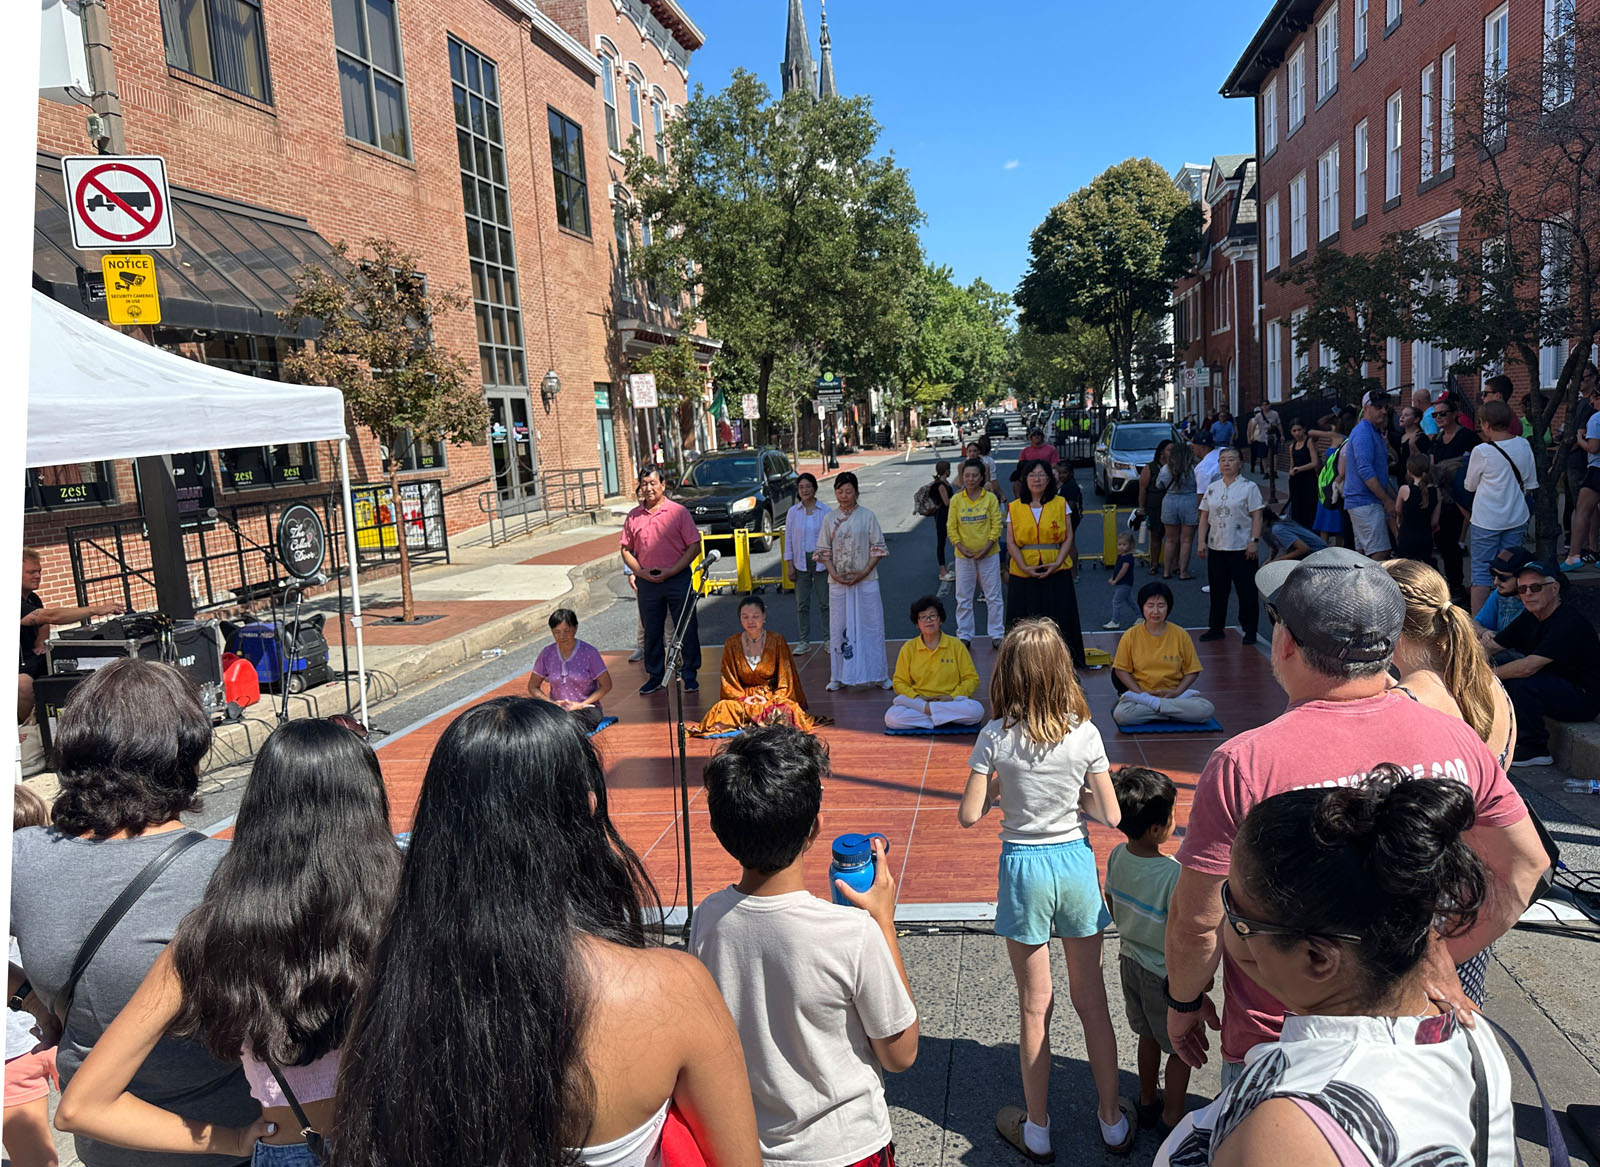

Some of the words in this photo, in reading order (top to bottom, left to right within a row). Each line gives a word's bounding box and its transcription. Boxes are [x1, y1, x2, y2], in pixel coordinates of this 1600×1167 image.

[108, 260, 149, 269] NOTICE
[234, 470, 253, 481] zest
[283, 466, 300, 477] zest
[60, 484, 87, 498] zest
[290, 523, 305, 538] The
[294, 550, 315, 562] Door
